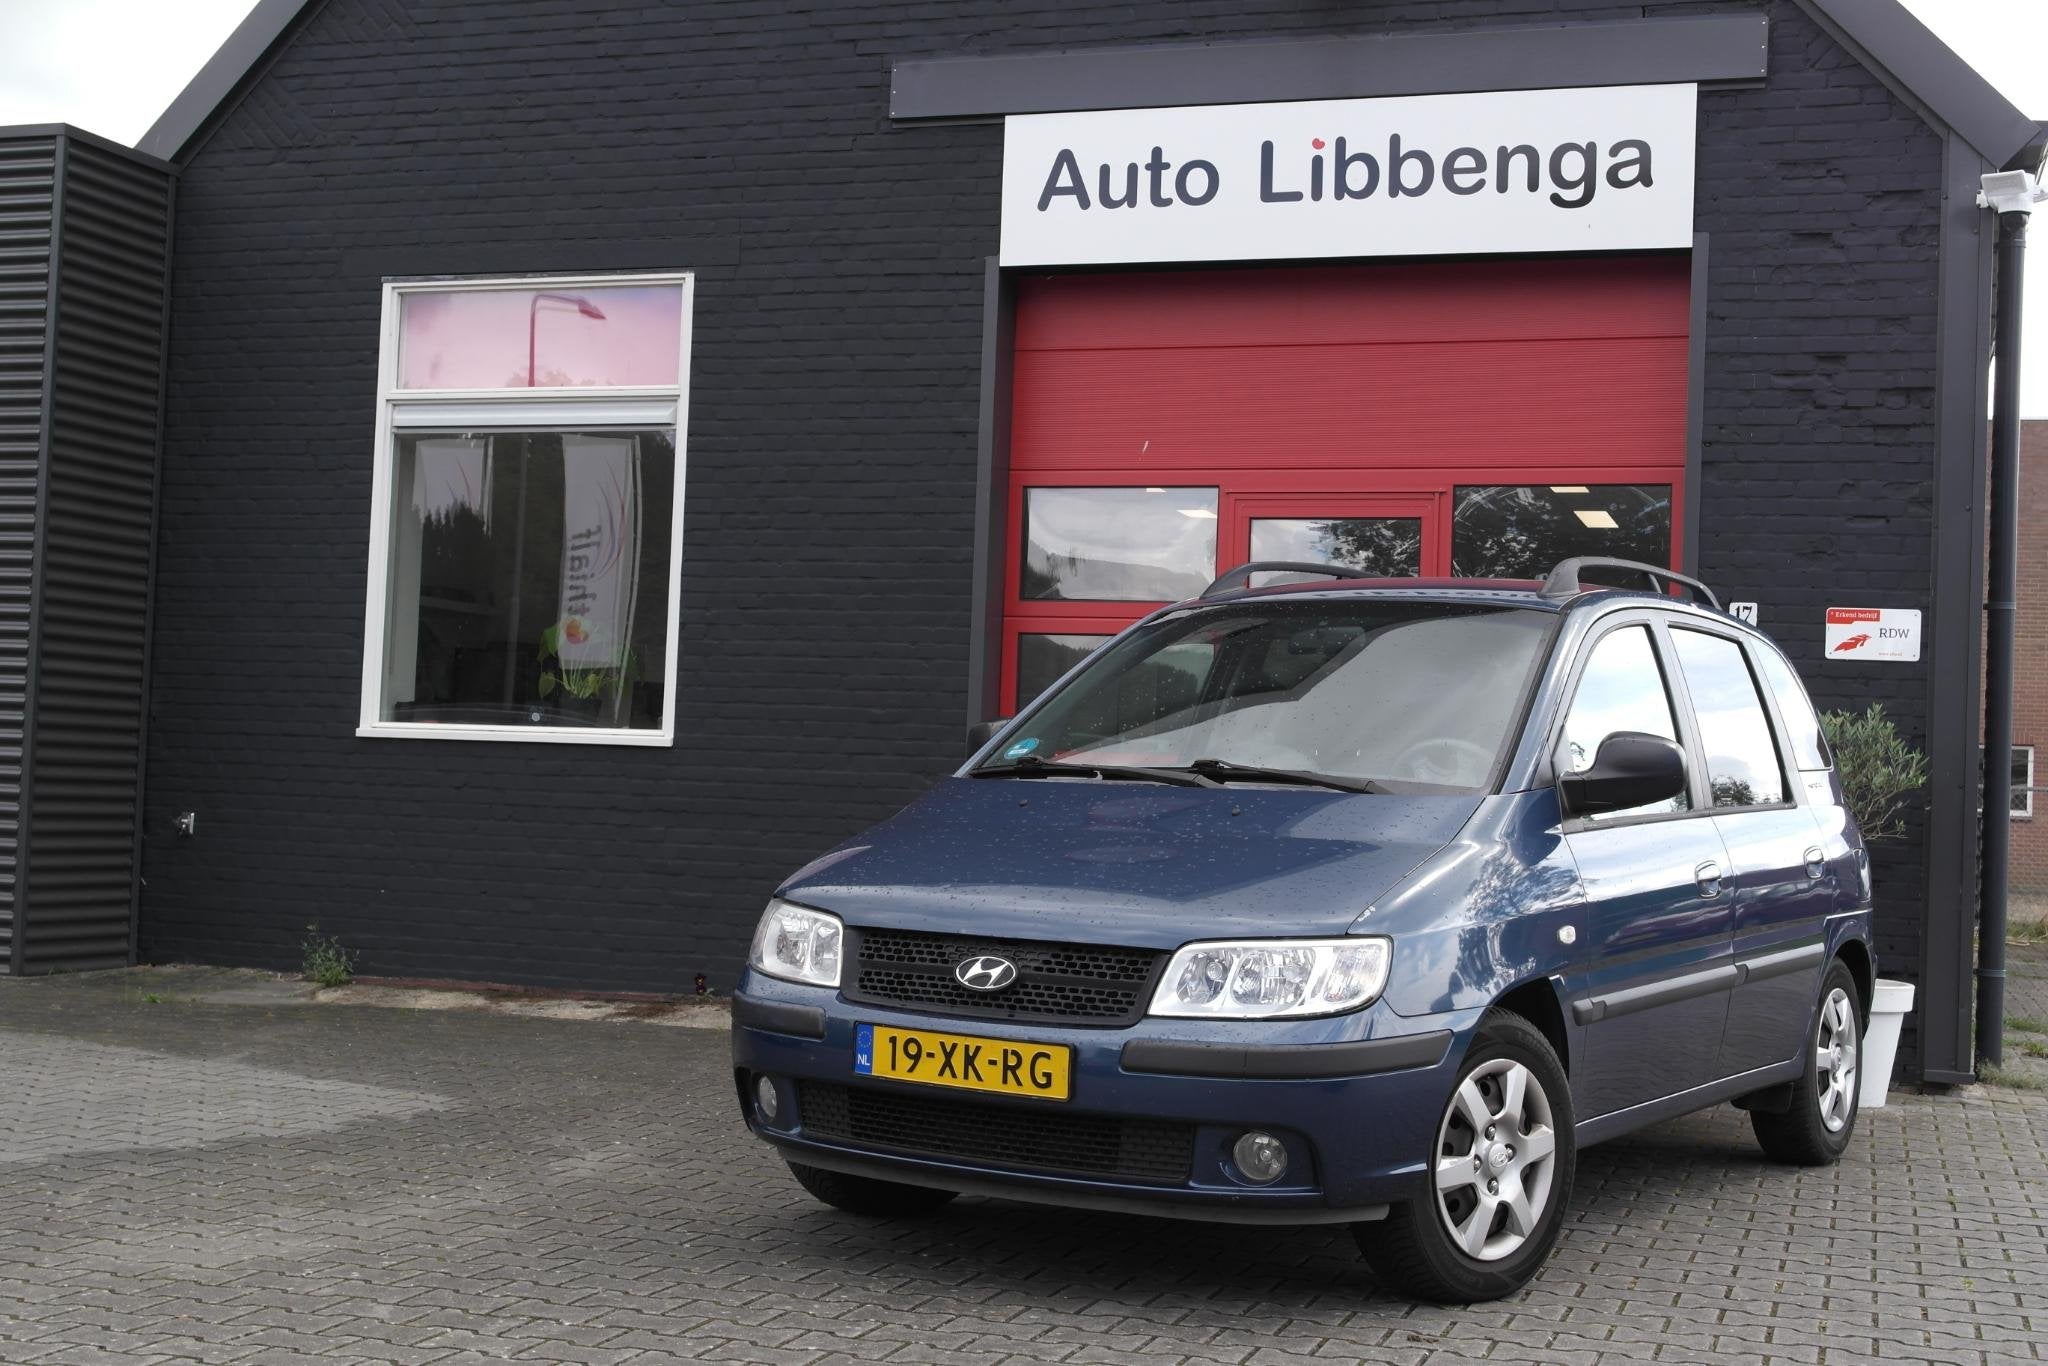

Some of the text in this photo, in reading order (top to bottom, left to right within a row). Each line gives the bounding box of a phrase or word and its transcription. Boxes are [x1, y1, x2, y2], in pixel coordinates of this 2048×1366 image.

[1037, 133, 1654, 212] Auto Libbenga
[1735, 606, 1753, 621] 17
[1857, 612, 1878, 620] bedrijf
[1879, 628, 1910, 639] RDW
[857, 1035, 1053, 1089] NL 19-XK-RG
